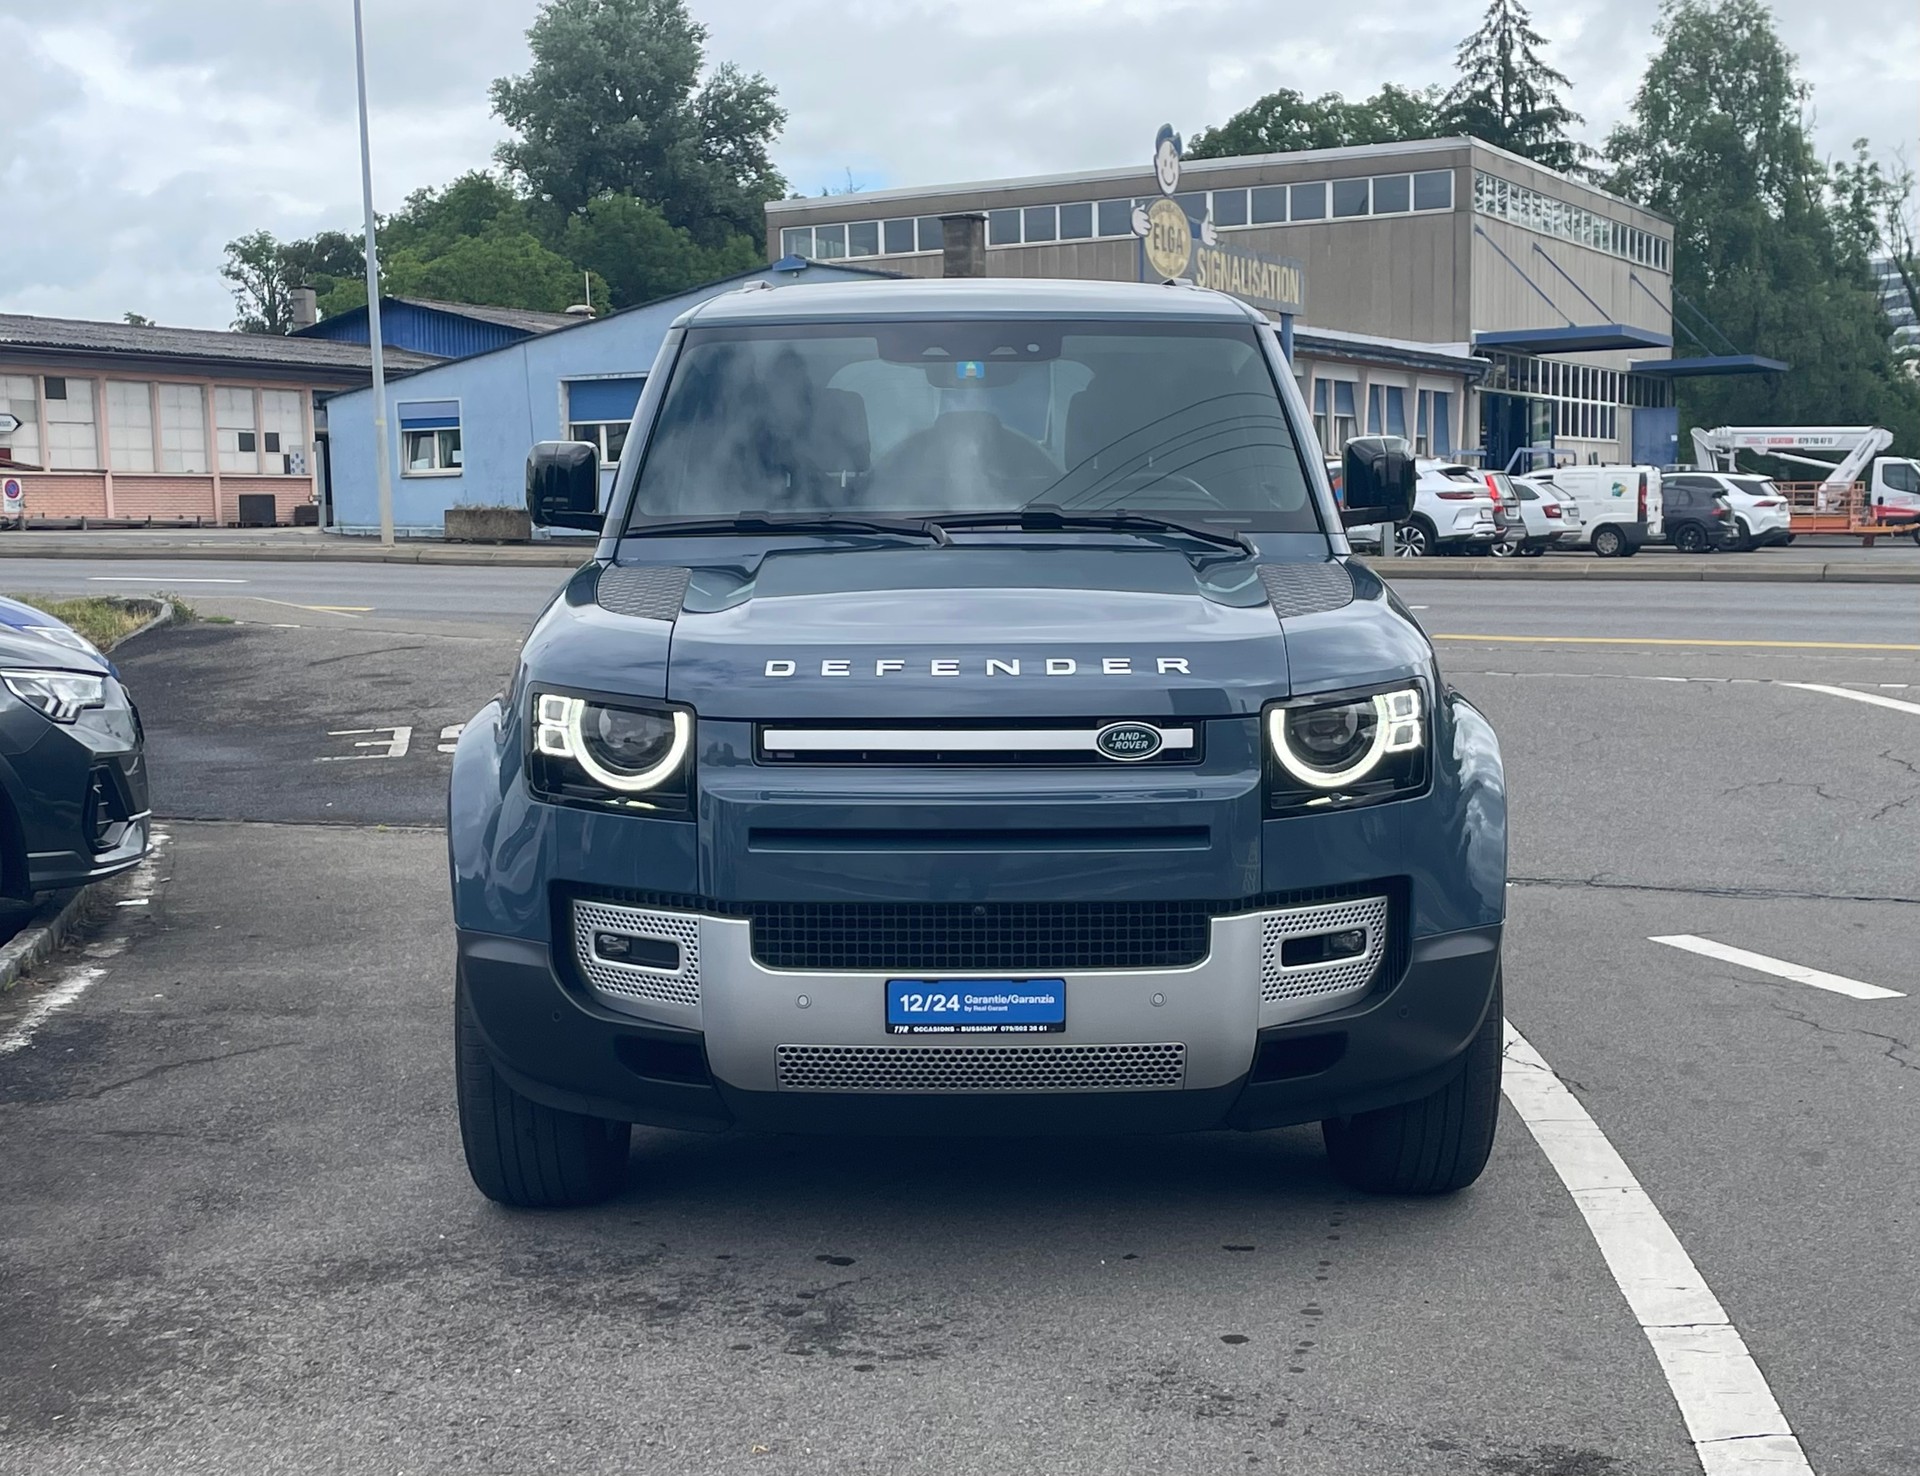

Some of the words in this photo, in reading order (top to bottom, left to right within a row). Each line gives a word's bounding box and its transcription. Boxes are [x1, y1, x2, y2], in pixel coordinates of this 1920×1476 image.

[1153, 223, 1184, 254] ELGA
[1196, 248, 1299, 304] SIGNALISATION
[764, 657, 1191, 677] DEFENDER
[900, 994, 960, 1012] 12/24
[964, 994, 1055, 1004] Garantie/Garanzia
[964, 1005, 972, 1013] by
